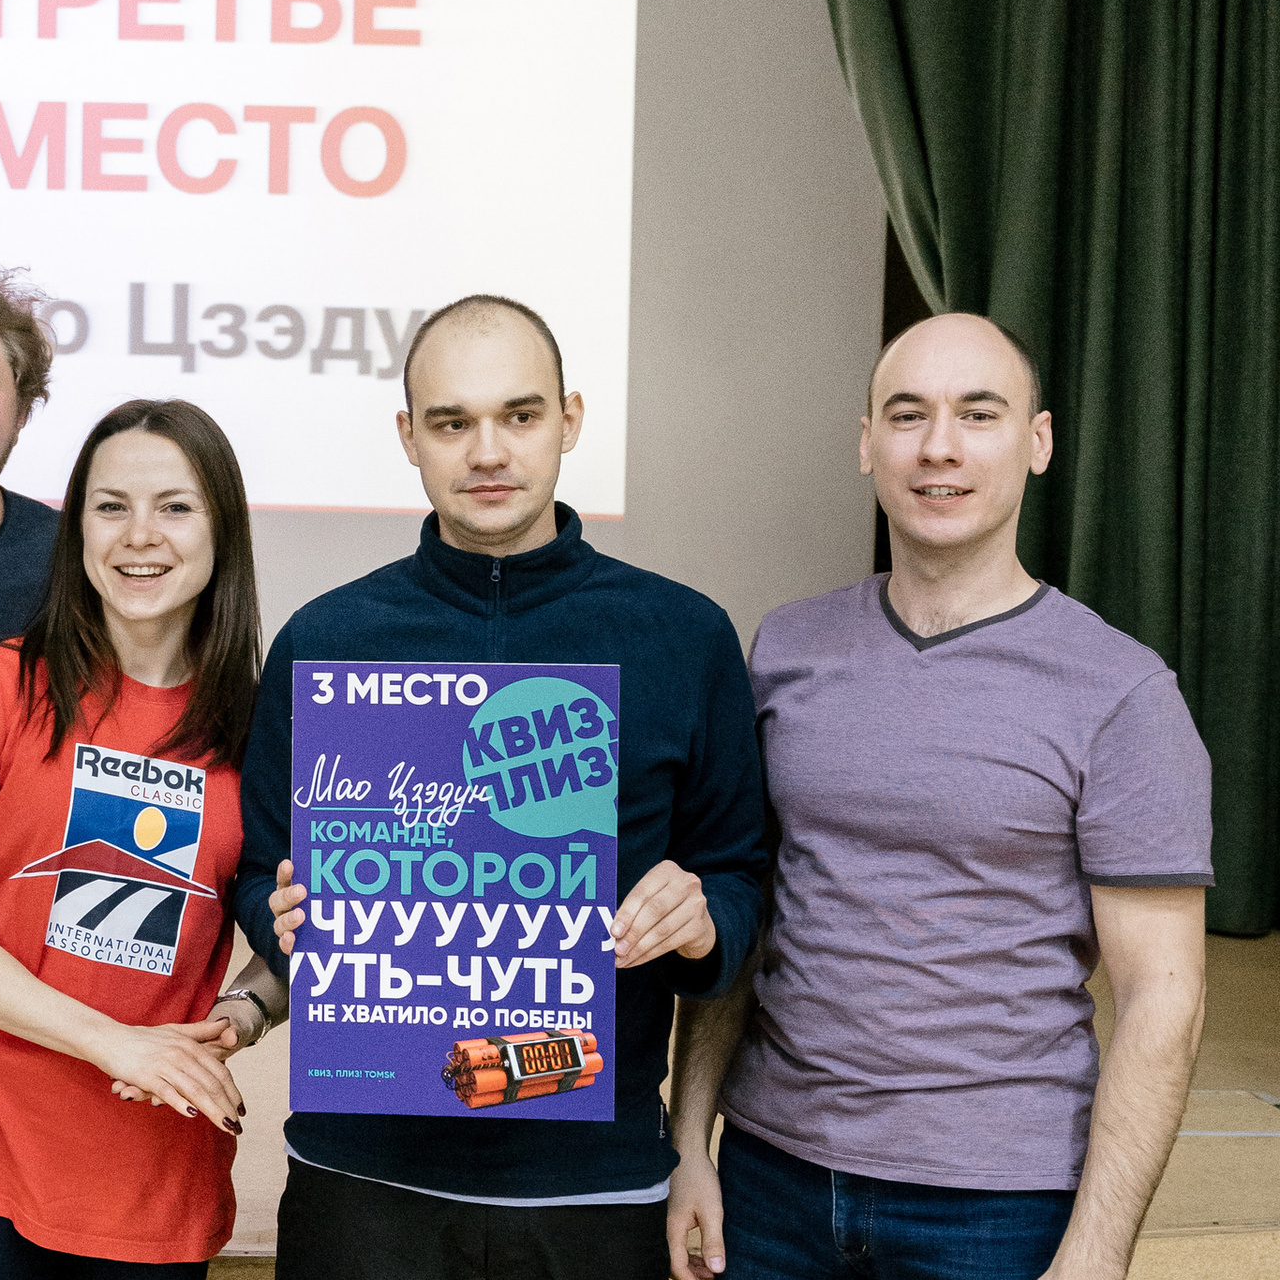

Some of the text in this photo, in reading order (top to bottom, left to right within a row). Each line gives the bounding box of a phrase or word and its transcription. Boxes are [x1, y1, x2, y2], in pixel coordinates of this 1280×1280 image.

[128, 282, 427, 380] Цзэду
[311, 672, 488, 706] 3 МЕСТО
[76, 745, 203, 795] Reebok
[130, 784, 202, 810] CLASSIC
[293, 753, 494, 828] Мао Цзэдун
[310, 820, 454, 848] КОМАНДЕ,
[310, 843, 597, 900] КОТОРОЙ
[46, 935, 172, 973] ASSOCIATION
[48, 922, 173, 961] INTERNATIONAL
[308, 1004, 592, 1031] НЕ ХВАТИЛО ДО ПОБЕДЫ
[307, 1069, 396, 1079] КВИЗ, ПЛИЗ! TOMSK
[522, 1041, 573, 1074] 00:01
